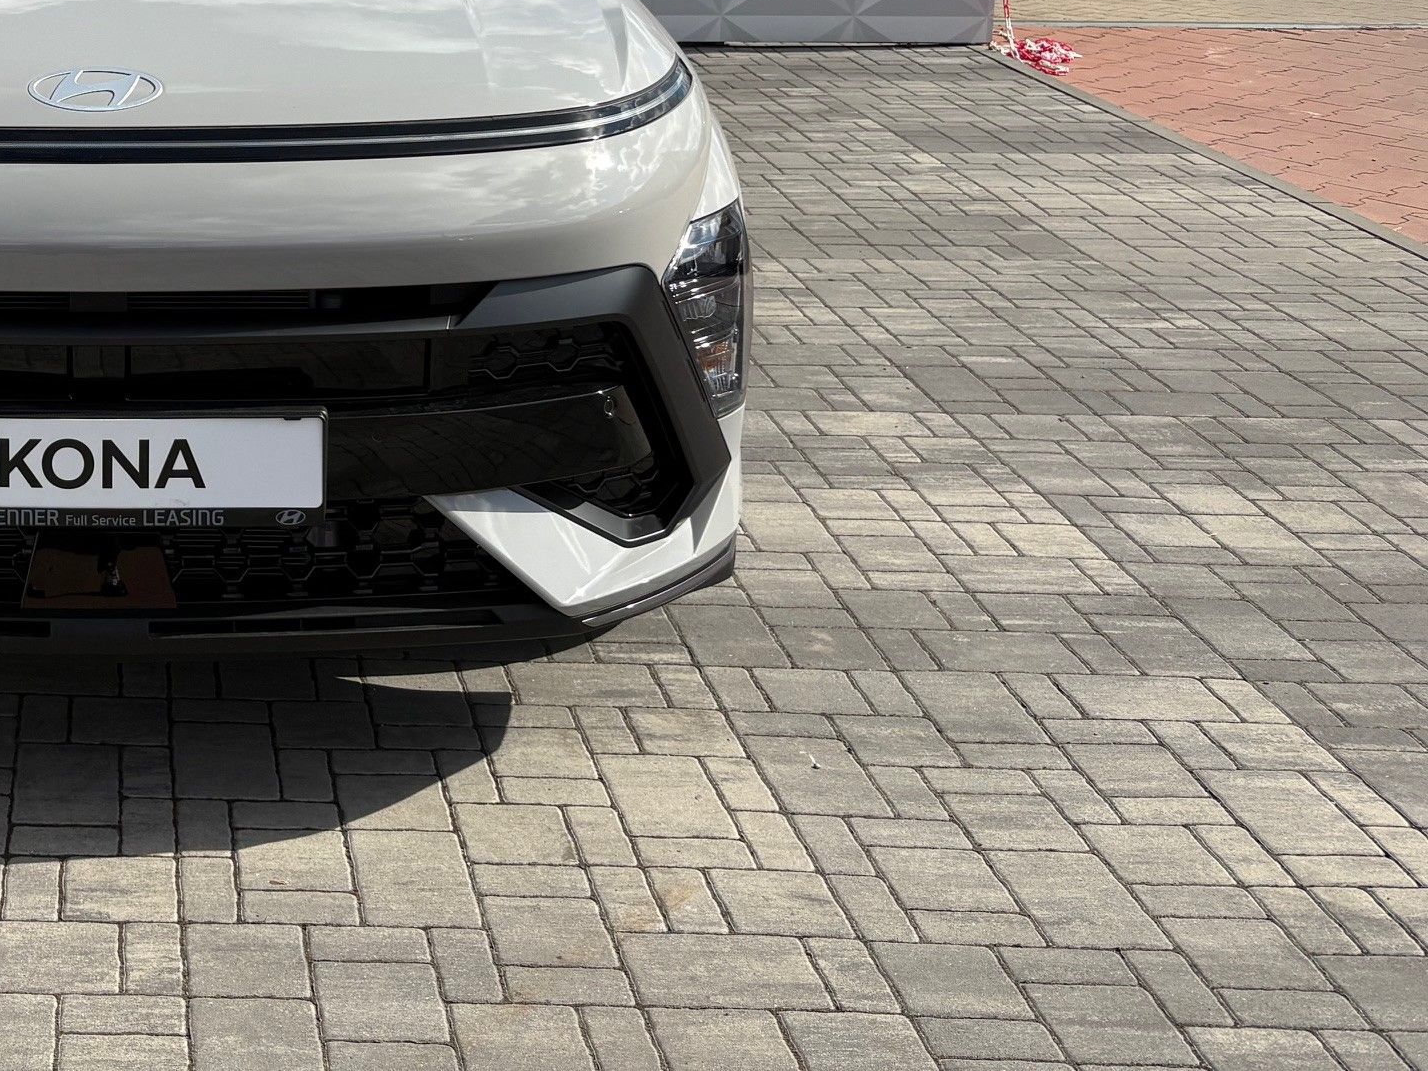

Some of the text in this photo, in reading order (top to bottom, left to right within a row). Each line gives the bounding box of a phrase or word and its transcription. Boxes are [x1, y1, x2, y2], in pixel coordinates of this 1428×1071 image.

[66, 515, 88, 526] Full
[92, 515, 136, 526] Service
[143, 509, 224, 526] LEASING
